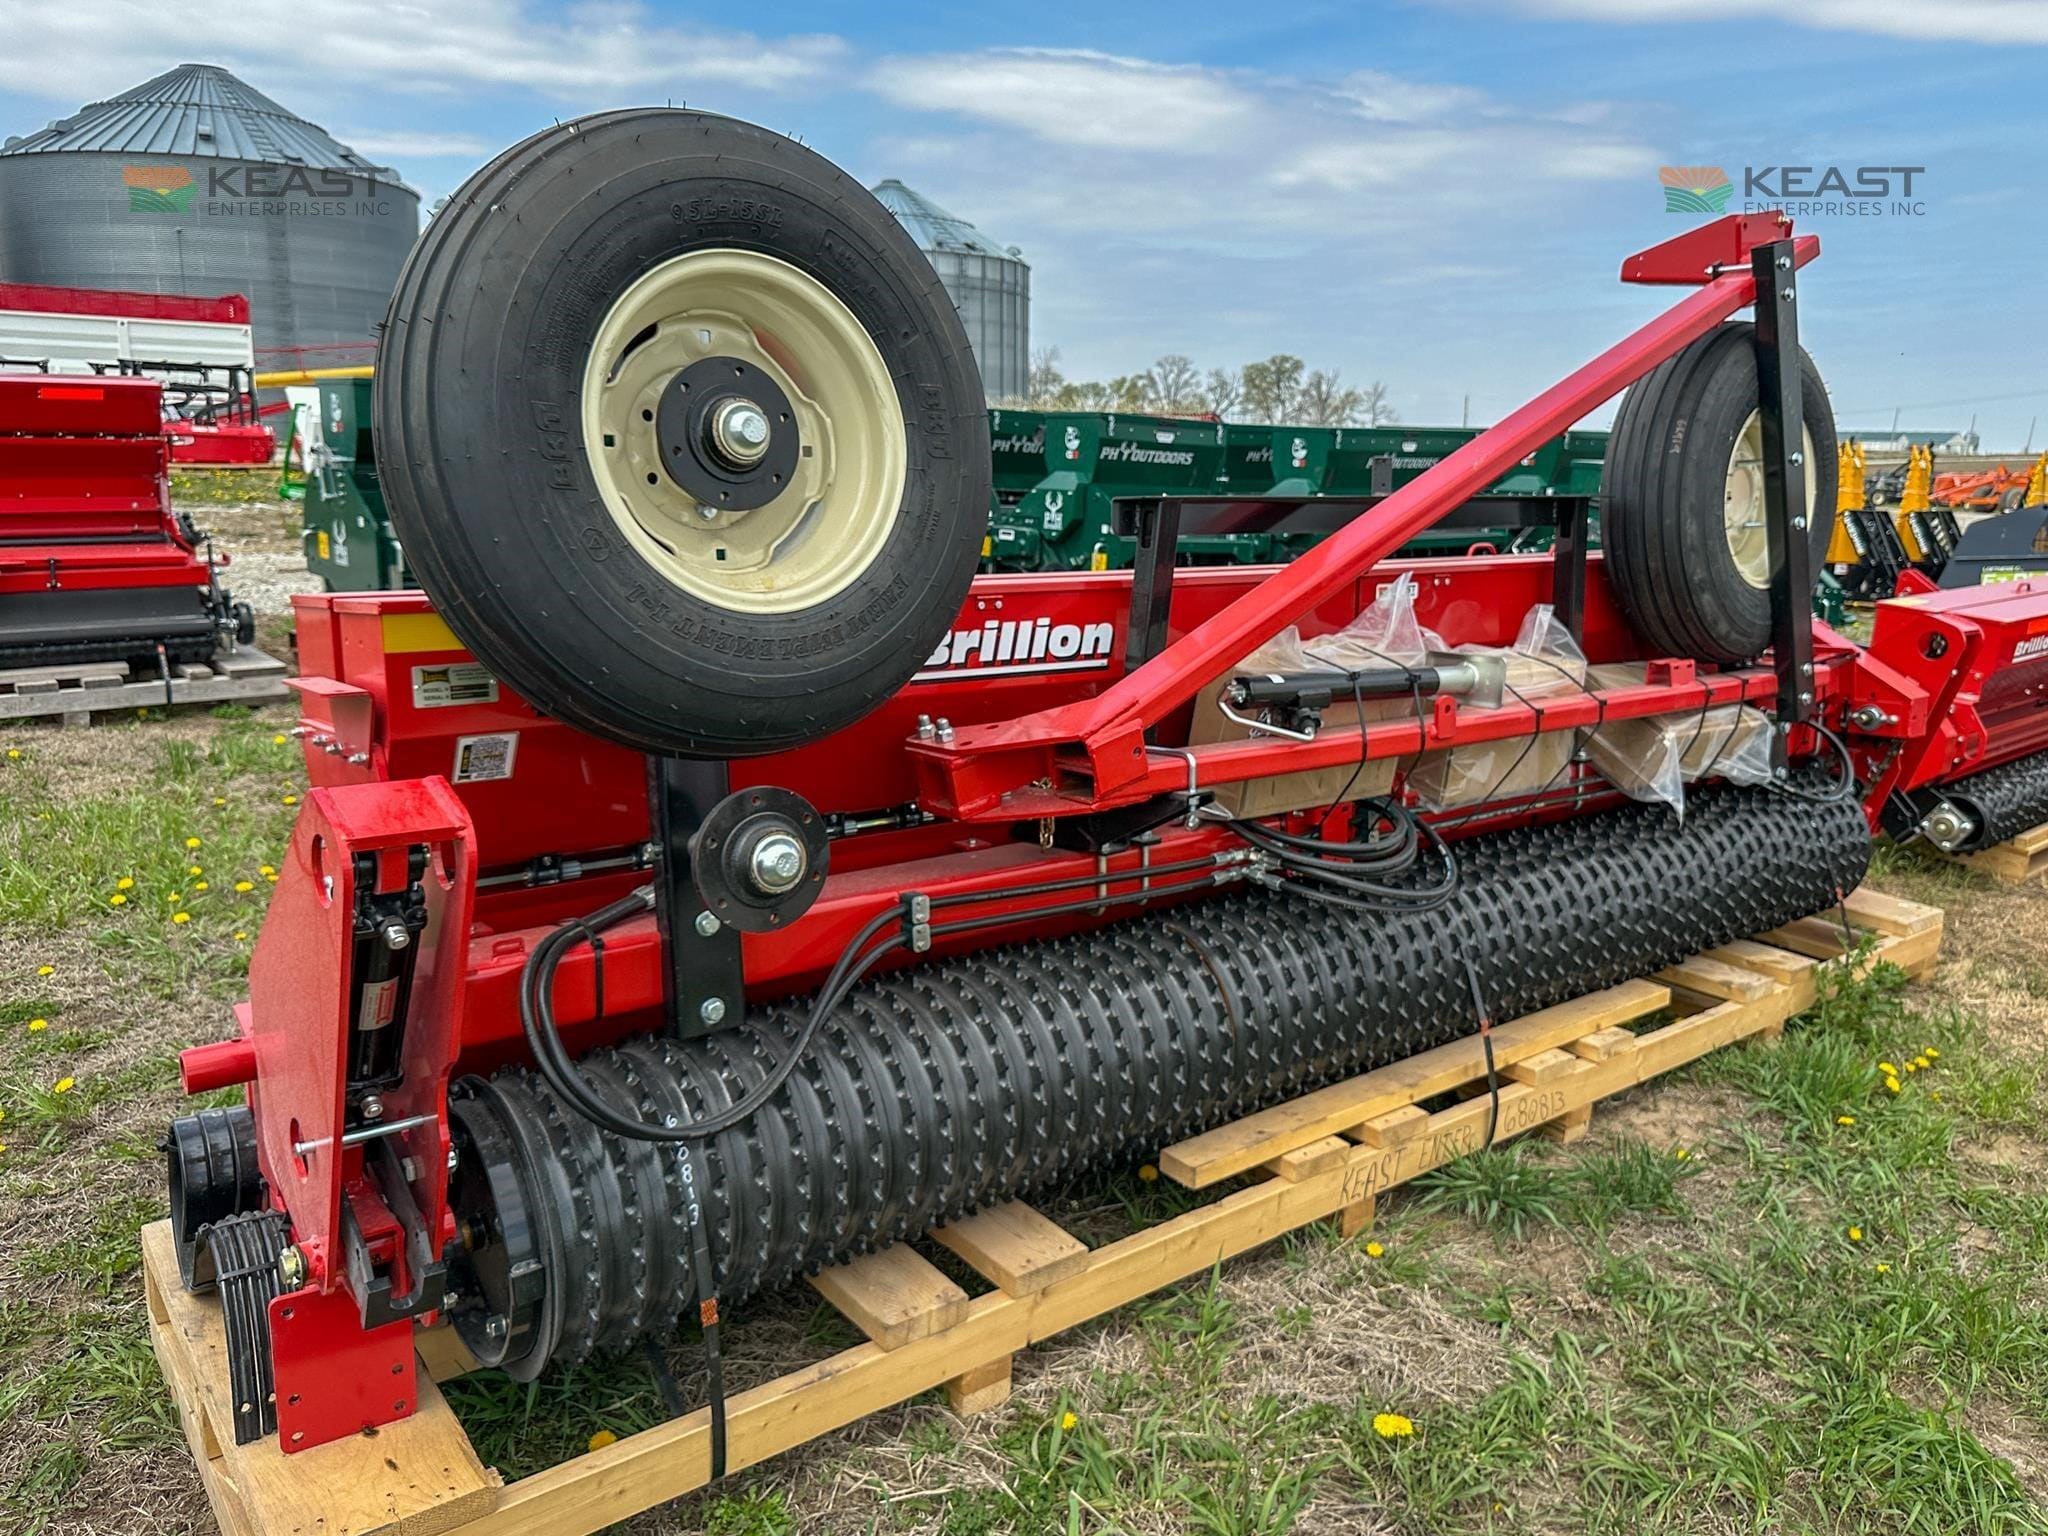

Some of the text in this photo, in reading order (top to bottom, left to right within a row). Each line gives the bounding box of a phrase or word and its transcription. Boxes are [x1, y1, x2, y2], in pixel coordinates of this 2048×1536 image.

[672, 618, 845, 661] IMPLEMENT
[665, 1114, 699, 1226] 60813
[1339, 1148, 1408, 1204] KEAST
[1503, 1091, 1566, 1133] 680813
